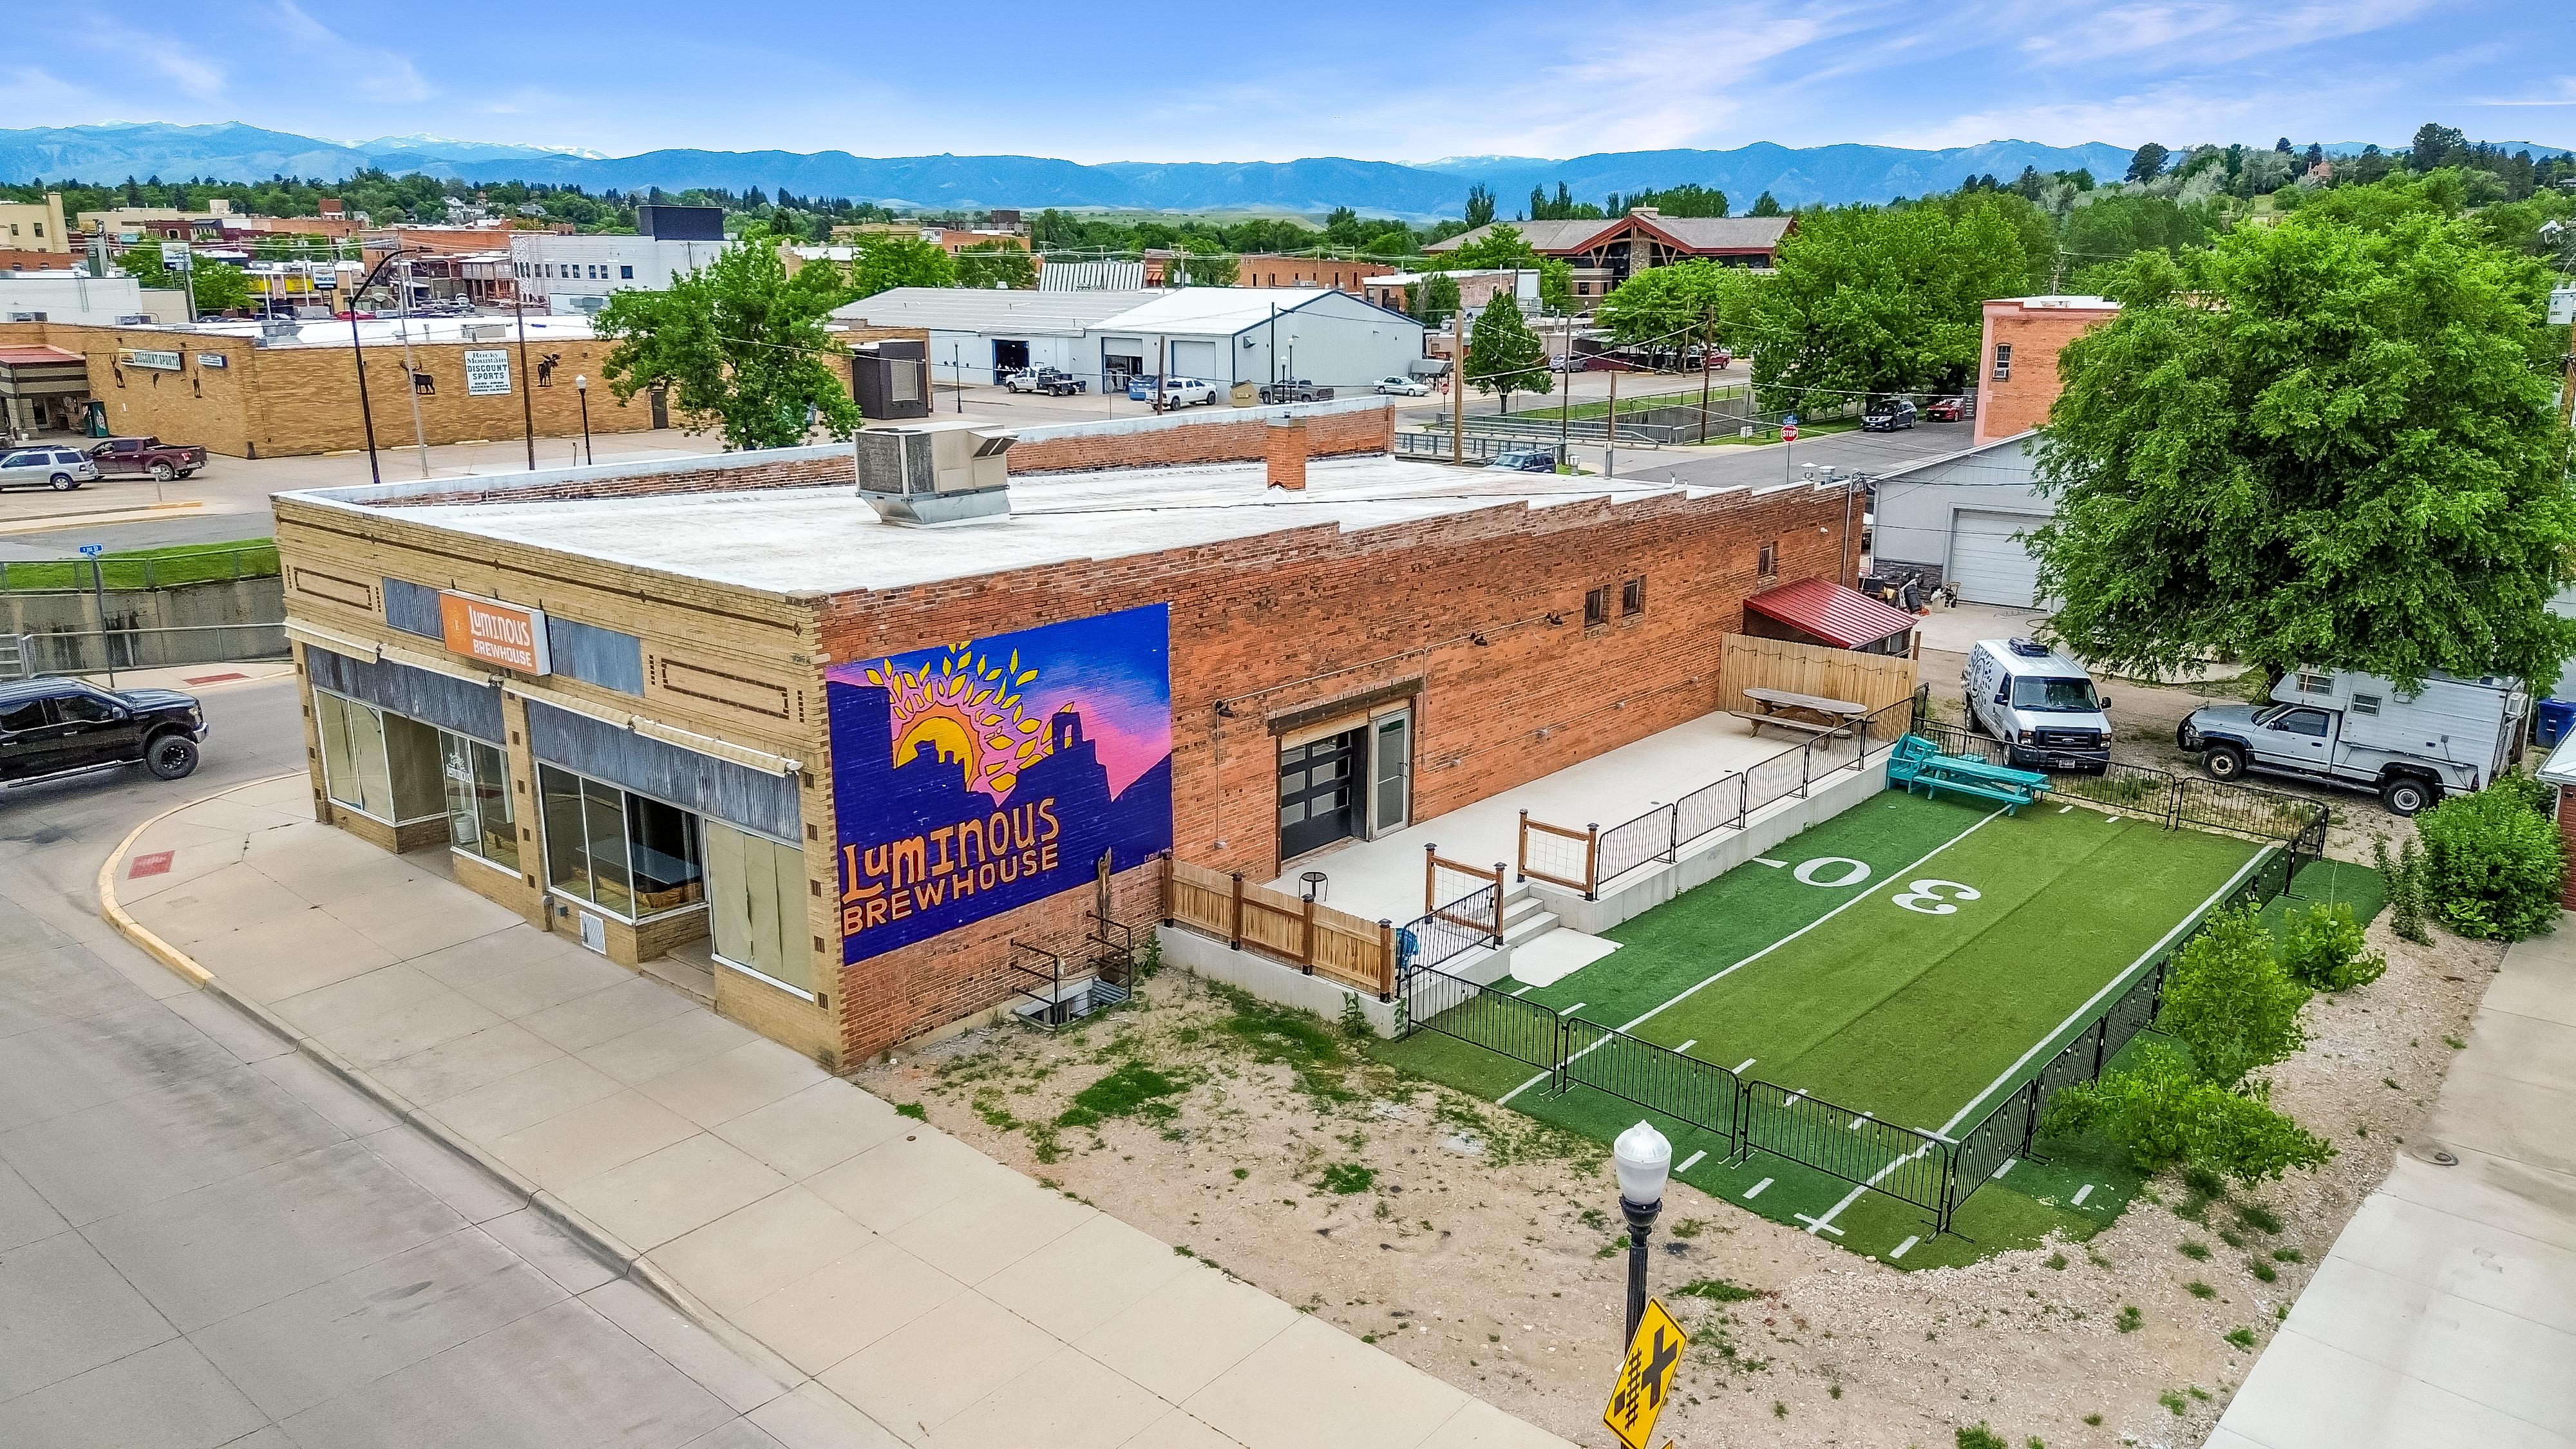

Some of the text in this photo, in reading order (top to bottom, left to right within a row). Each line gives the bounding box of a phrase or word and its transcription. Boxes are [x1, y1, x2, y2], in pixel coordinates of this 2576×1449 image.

[135, 352, 158, 365] DISCOUNT
[159, 354, 179, 366] SPORTS
[473, 638, 533, 667] BREWHOUSE
[843, 843, 1058, 936] BREWHOUSE
